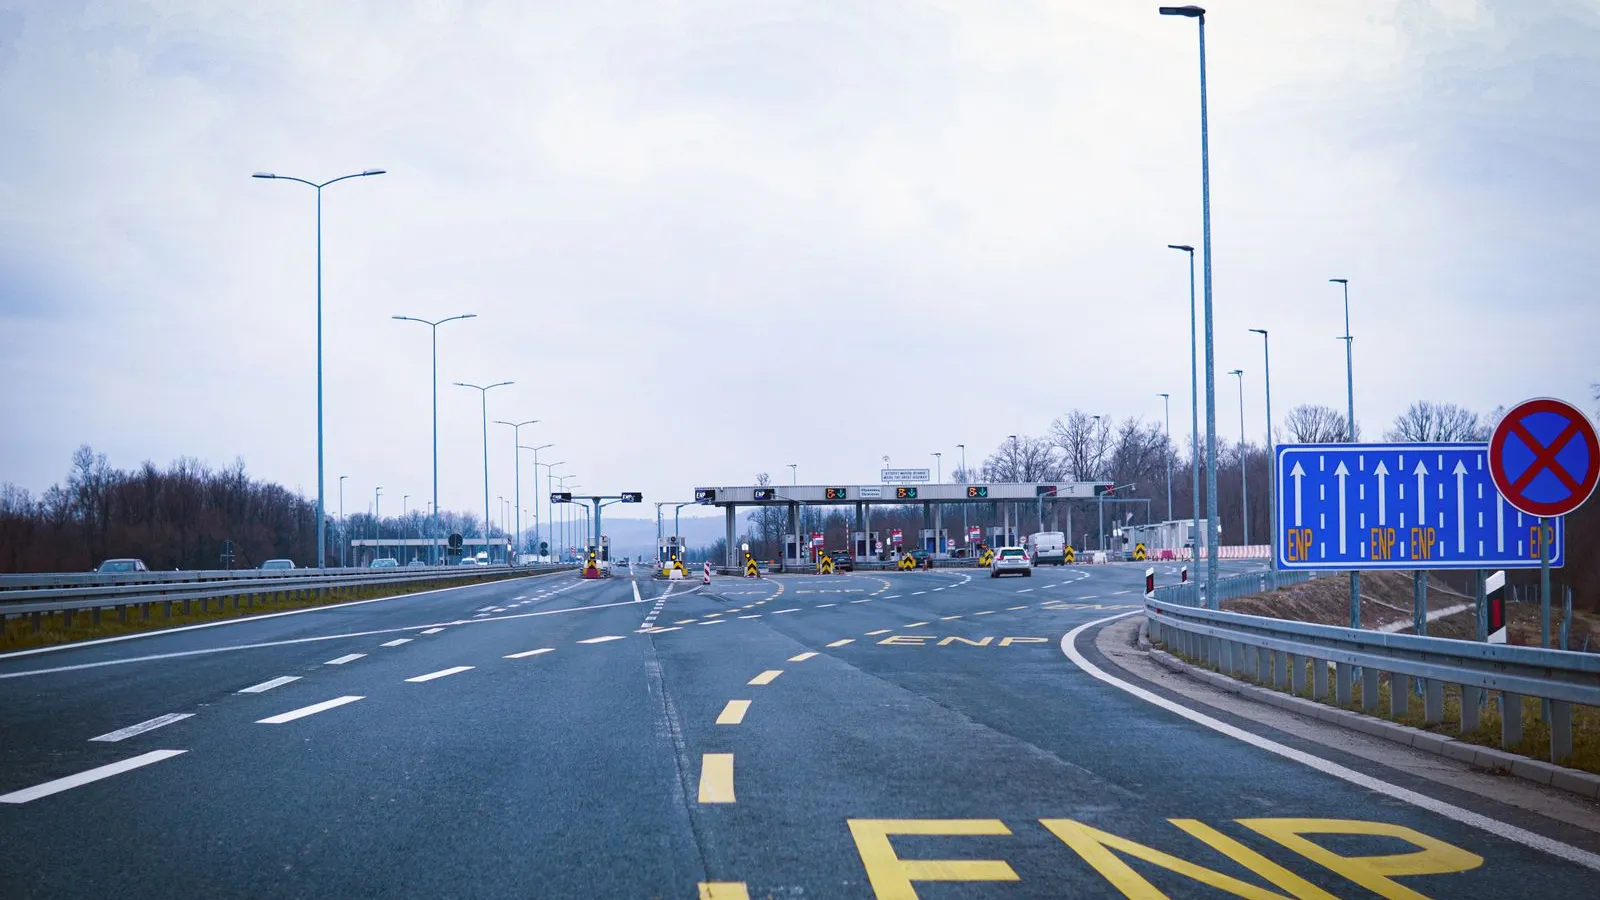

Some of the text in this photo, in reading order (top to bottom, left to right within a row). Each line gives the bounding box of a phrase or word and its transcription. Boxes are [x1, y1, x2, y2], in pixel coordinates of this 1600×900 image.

[1288, 528, 1313, 561] ENP
[1371, 527, 1396, 560] ENP
[1411, 527, 1436, 560] ENP
[876, 635, 1049, 647] ENP
